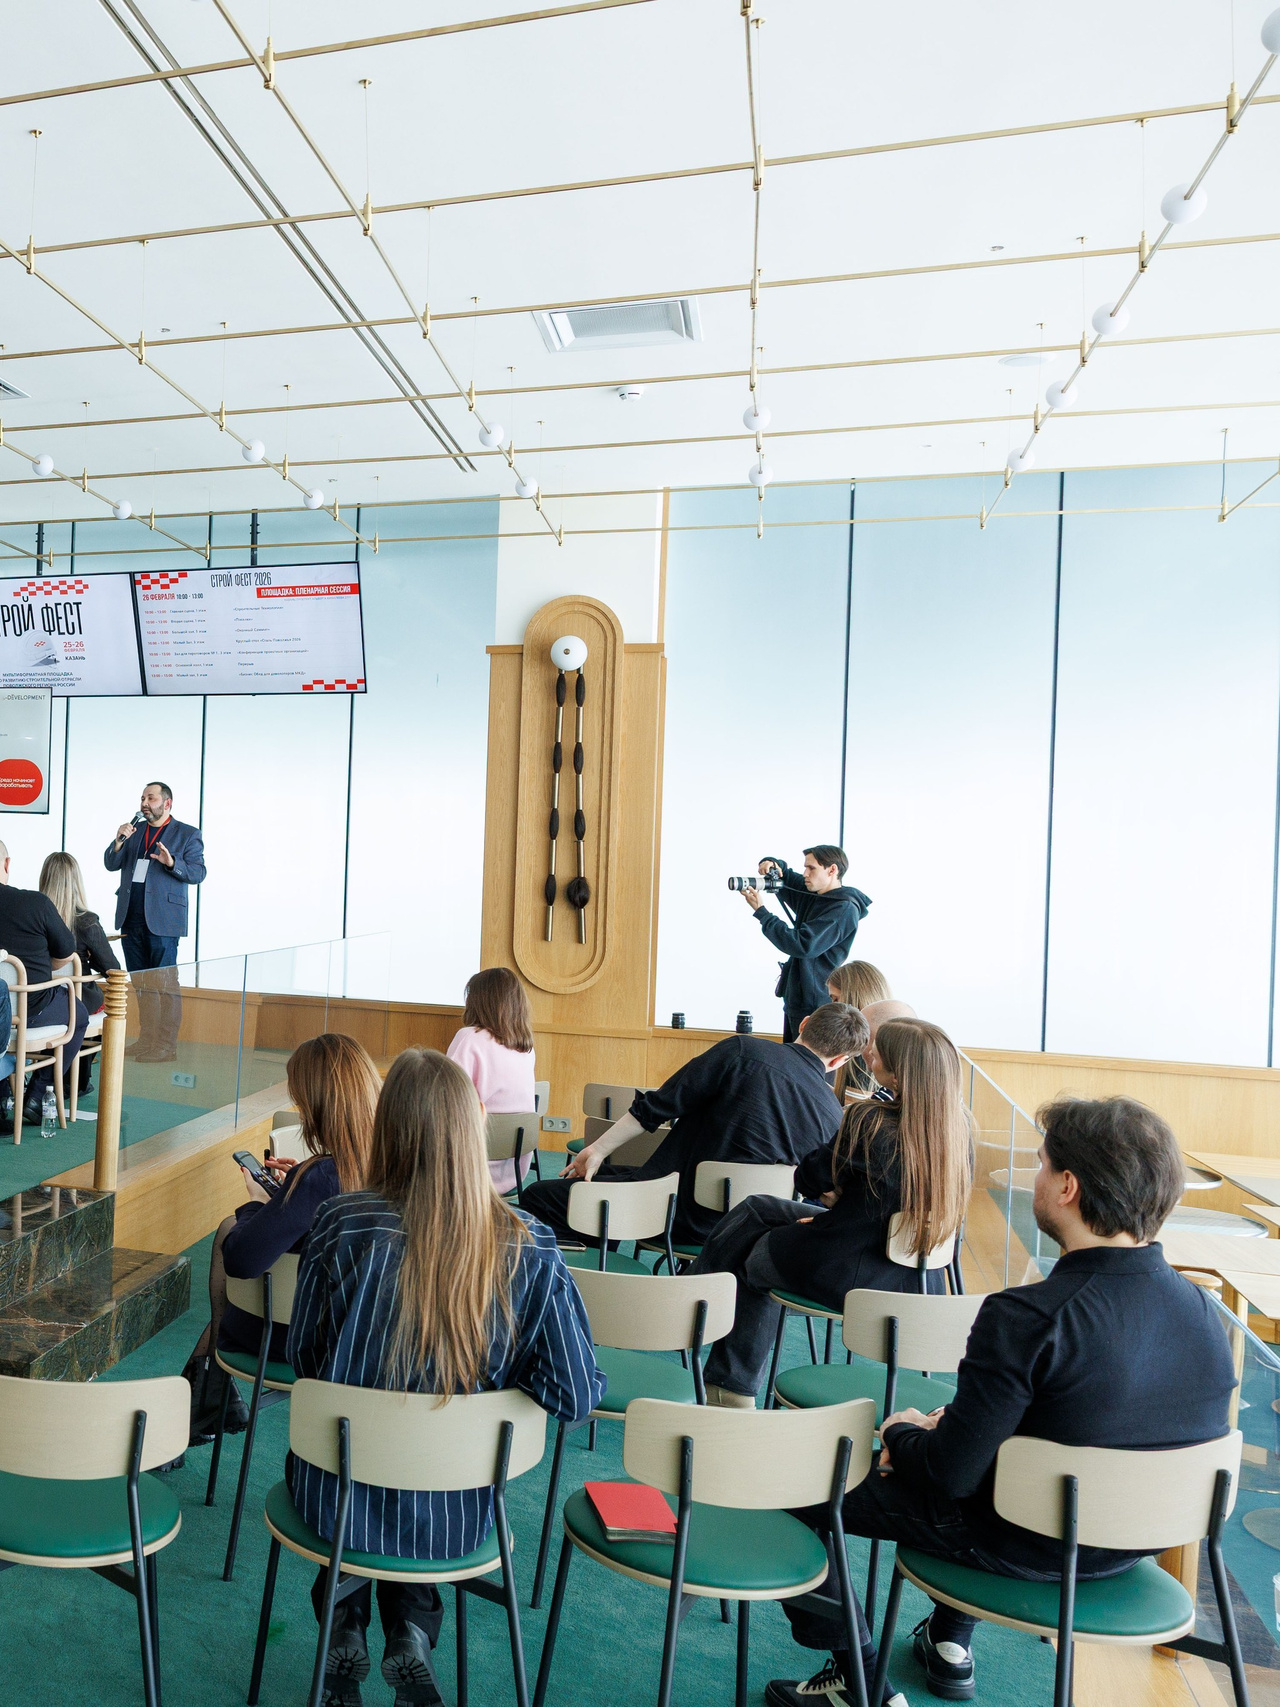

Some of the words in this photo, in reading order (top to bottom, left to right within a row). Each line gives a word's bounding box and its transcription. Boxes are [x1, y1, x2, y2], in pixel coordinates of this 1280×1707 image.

[210, 571, 233, 588] СТРОЙ
[235, 572, 252, 587] ФЕСТ
[254, 571, 272, 586] 2026
[295, 586, 329, 595] ПЛЕНАРНАЯ
[329, 585, 351, 593] СЕССИЯ
[149, 593, 176, 601] ФЕВРАЛЯ
[40, 602, 82, 636] ФЕСТ
